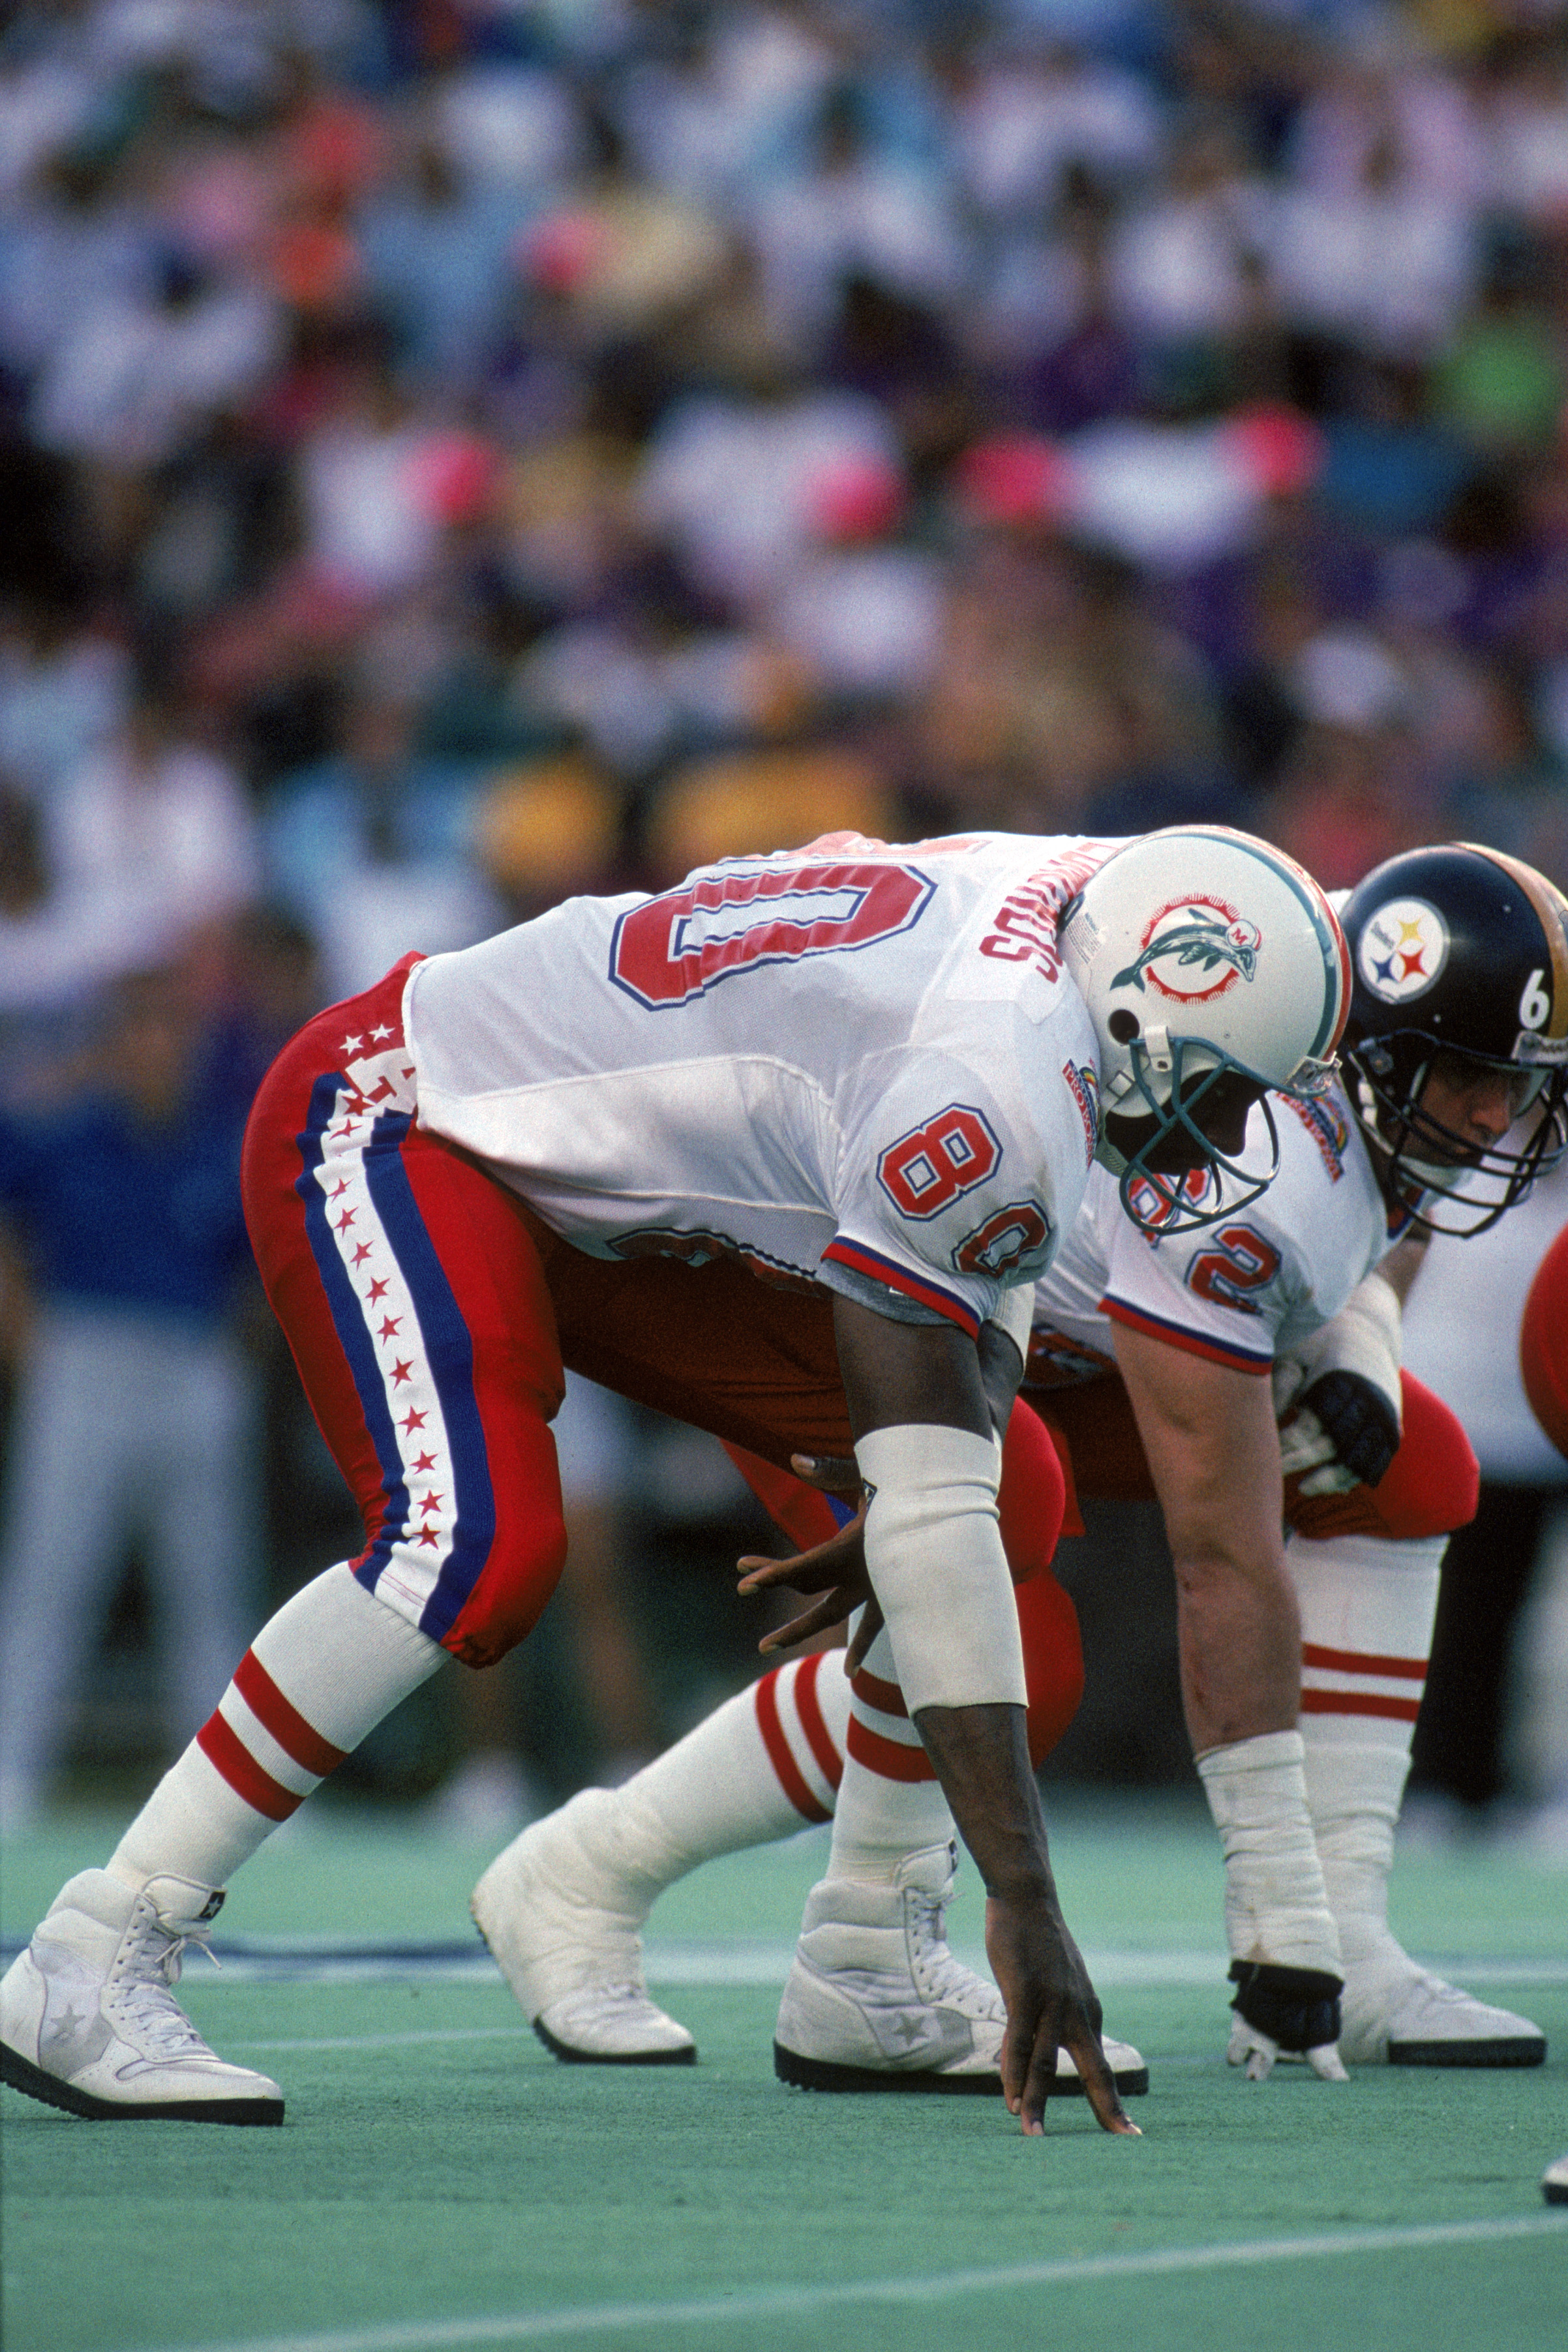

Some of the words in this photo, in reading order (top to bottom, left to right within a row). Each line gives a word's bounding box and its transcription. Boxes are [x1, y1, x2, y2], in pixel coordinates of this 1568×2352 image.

[609, 831, 992, 1012] 0
[1231, 927, 1248, 946] M
[1518, 969, 1550, 1030] 6
[1064, 1066, 1085, 1107] PRO
[876, 1102, 1052, 1280] 80
